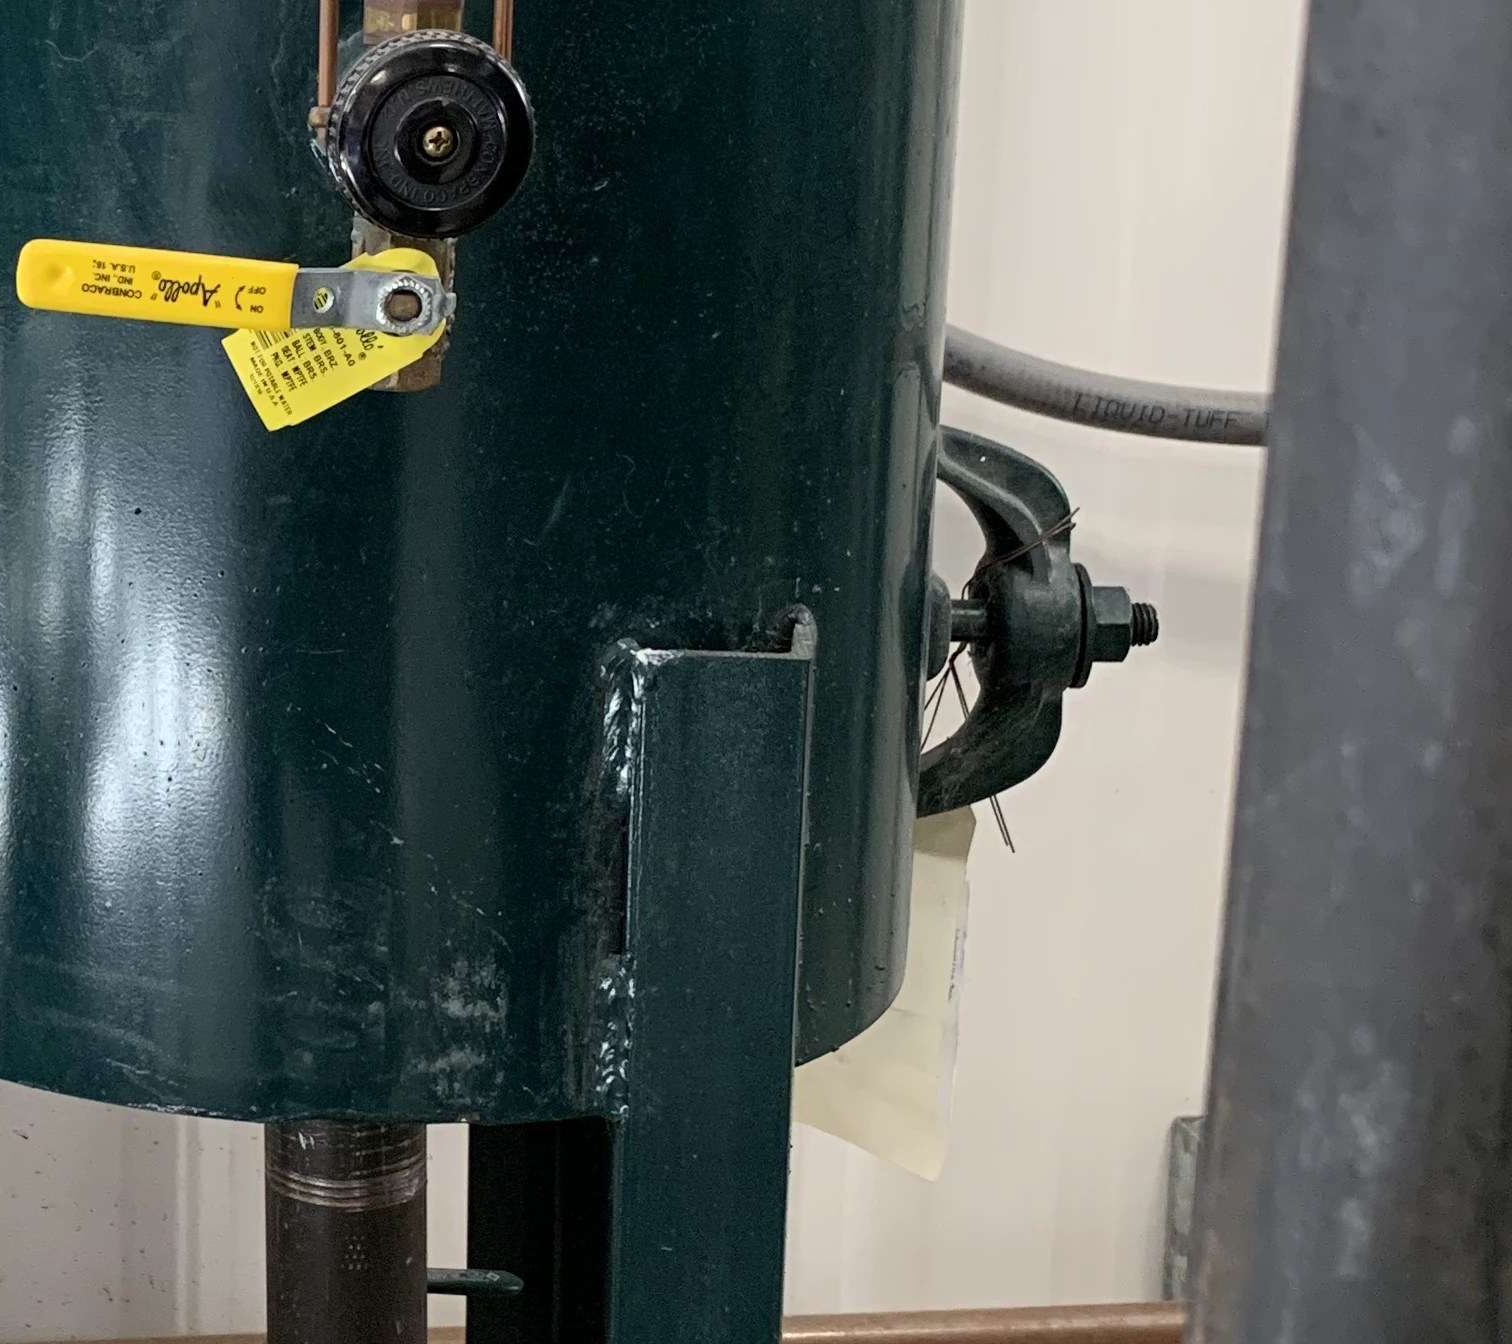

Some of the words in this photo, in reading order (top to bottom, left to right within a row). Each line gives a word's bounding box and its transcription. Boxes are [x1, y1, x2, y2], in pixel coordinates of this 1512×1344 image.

[81, 283, 142, 299] CONBRACO
[247, 286, 266, 295] OFF
[250, 304, 264, 313] ON
